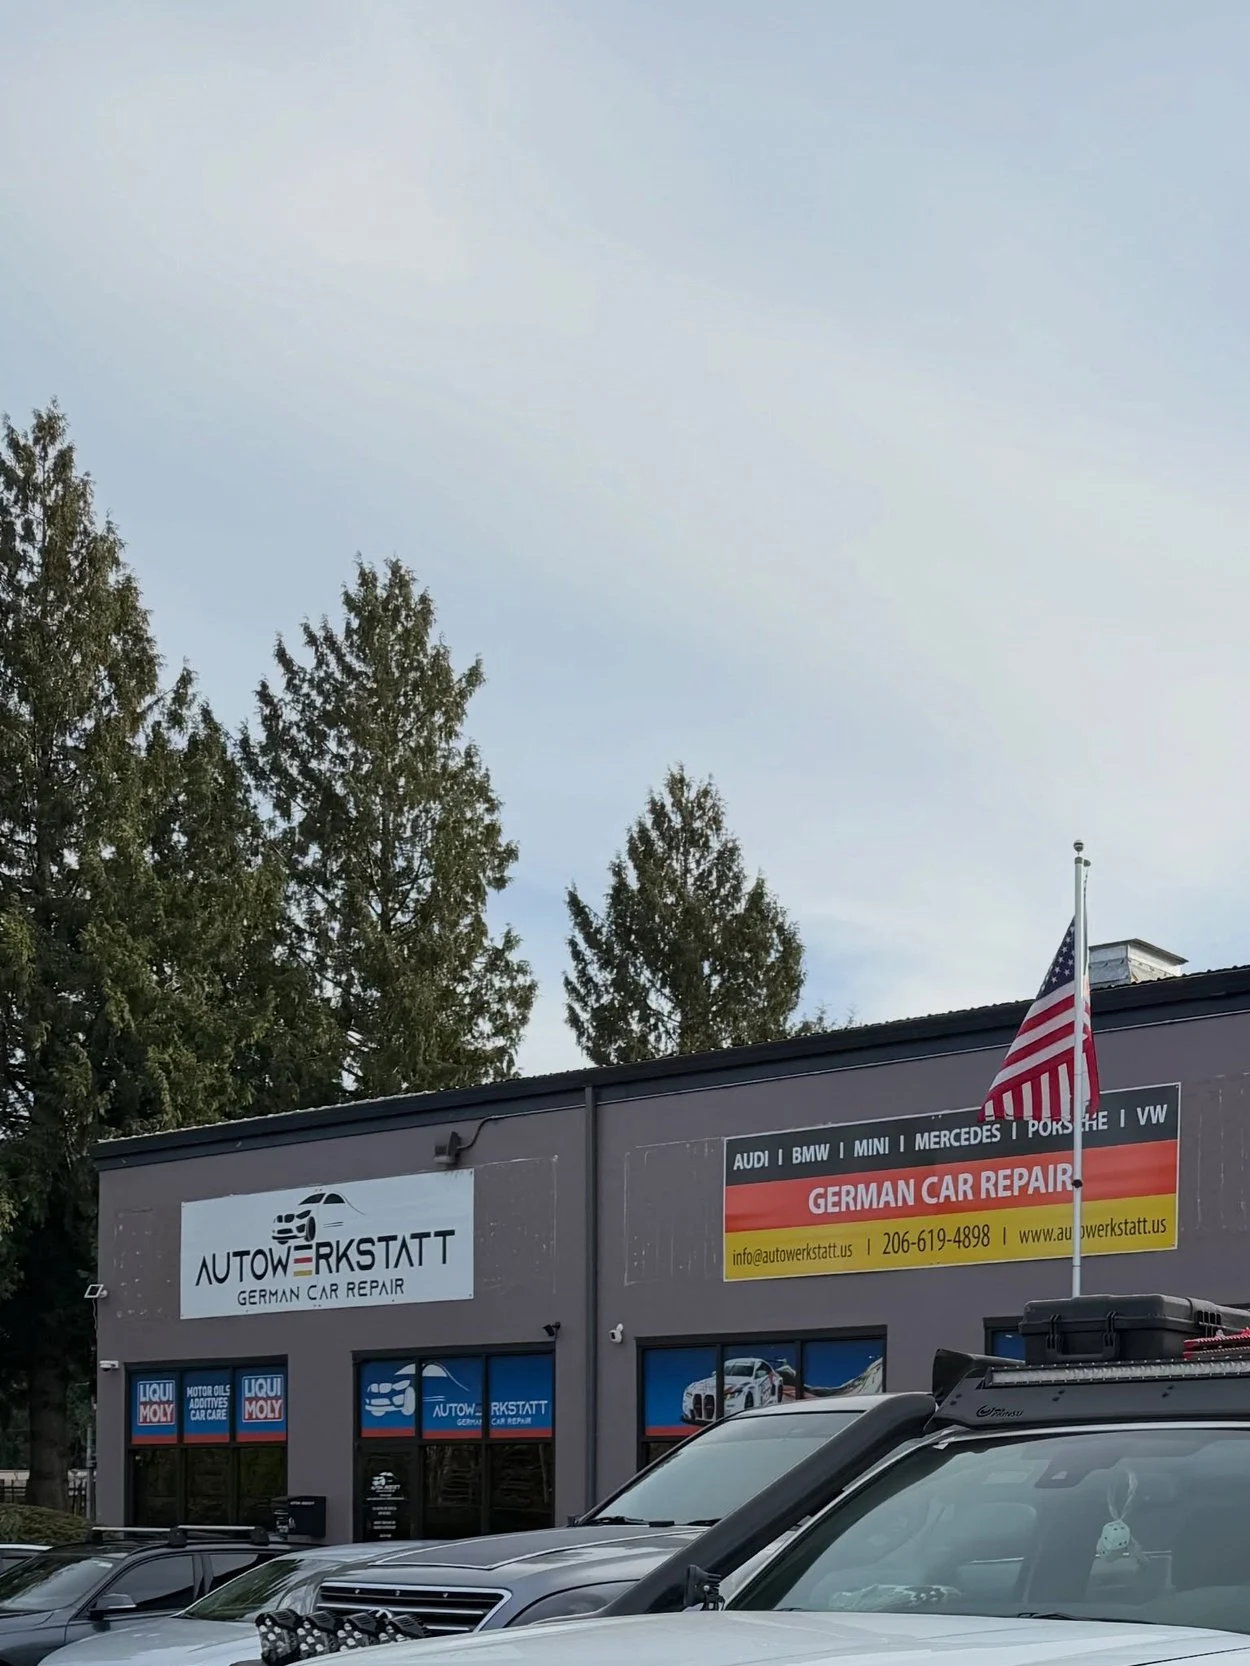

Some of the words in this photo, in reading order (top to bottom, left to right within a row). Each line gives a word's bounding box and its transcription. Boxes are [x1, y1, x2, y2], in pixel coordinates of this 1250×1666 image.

[733, 1151, 769, 1171] AUDI
[792, 1143, 830, 1164] BMW
[854, 1136, 889, 1158] MINI
[915, 1123, 1001, 1151] MERCEDES
[1028, 1111, 1109, 1139] PORSHE
[1136, 1104, 1168, 1126] VW
[808, 1178, 915, 1215] GERMAN
[921, 1172, 974, 1205] CAR
[980, 1162, 1074, 1200] REPAIR
[732, 1242, 853, 1267] info@autowerkstatt.us
[882, 1223, 991, 1255] 206-619-4898
[1019, 1216, 1167, 1245] www.auowerkstatt.us
[195, 1229, 455, 1286] AUTOWERKSTATT
[237, 1286, 301, 1306] GERMAN
[307, 1282, 339, 1301] CAR
[346, 1278, 405, 1297] REPAIR
[139, 1382, 173, 1402] LIQUI
[186, 1386, 213, 1398] MOTOR
[213, 1384, 230, 1396] OILS
[244, 1377, 281, 1398] LIQUI
[139, 1403, 175, 1423] MOLY
[188, 1397, 229, 1410] ADDITIVES
[244, 1399, 283, 1420] MOLY
[190, 1410, 206, 1421] CAR
[206, 1409, 228, 1420] CARE
